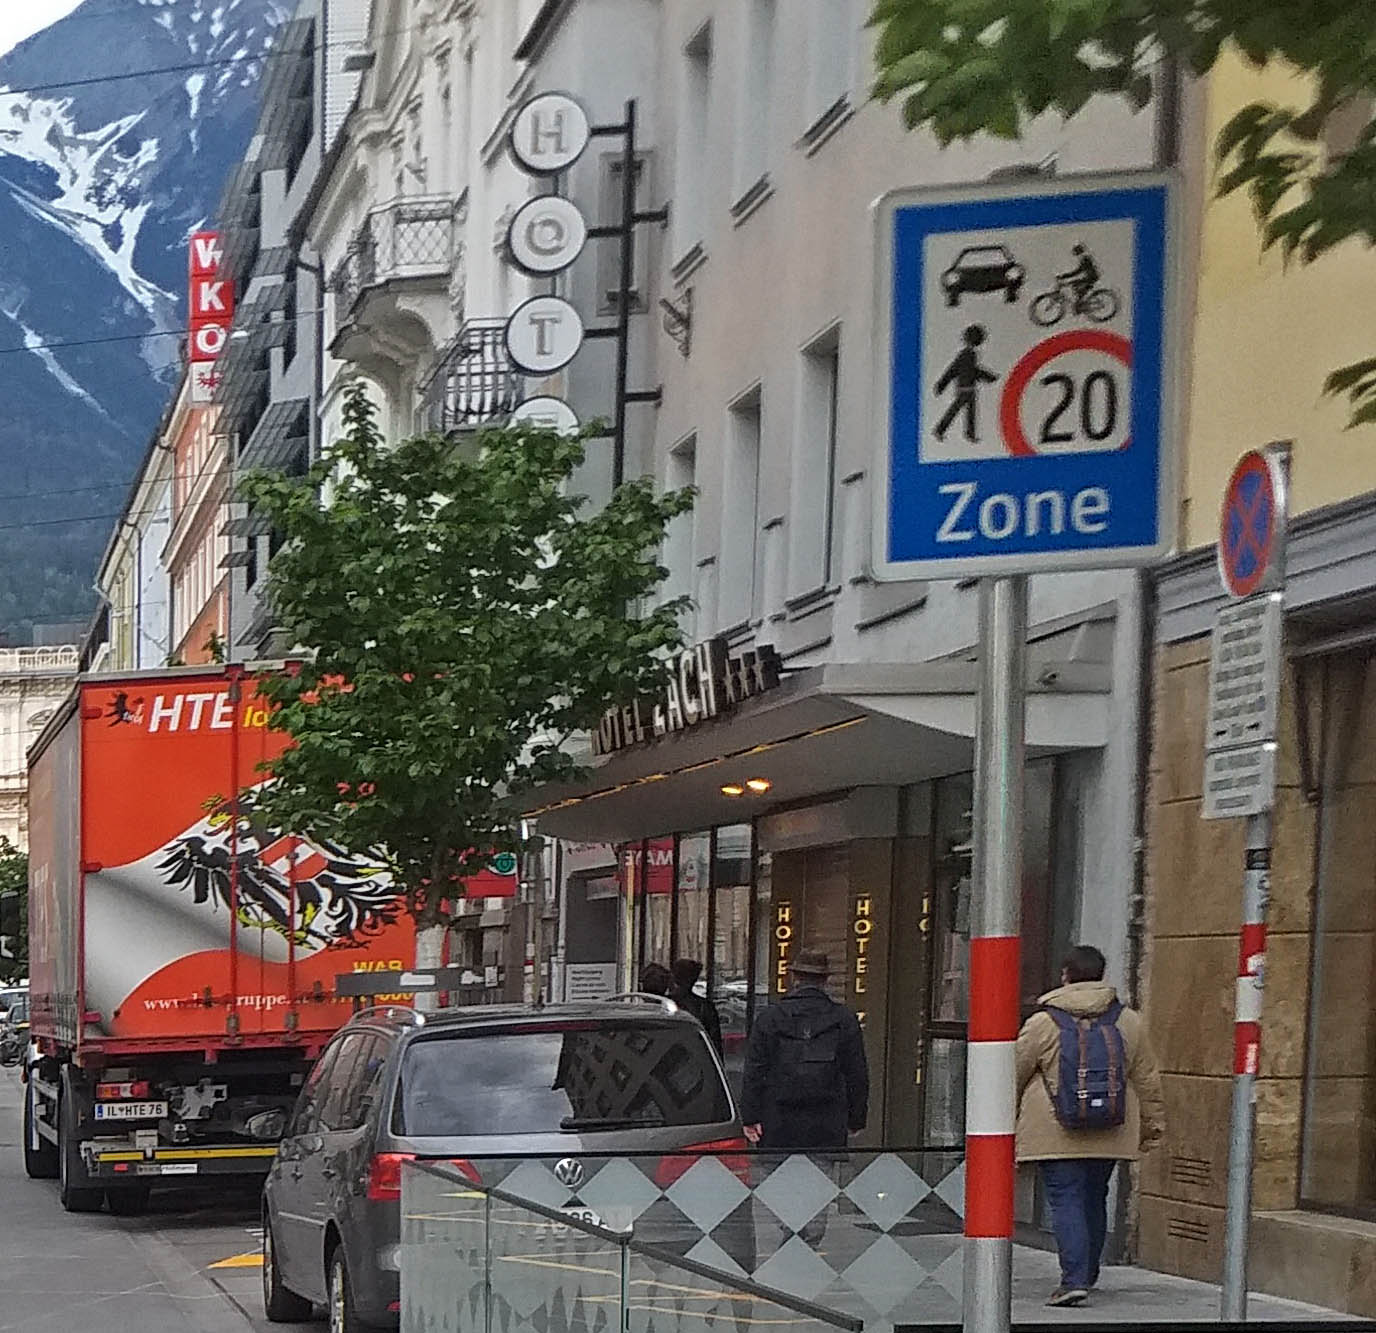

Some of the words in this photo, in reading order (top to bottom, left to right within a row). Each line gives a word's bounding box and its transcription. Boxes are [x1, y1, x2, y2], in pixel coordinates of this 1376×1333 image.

[1038, 370, 1118, 446] 20
[936, 482, 1111, 543] Zone
[149, 692, 233, 733] HTE
[776, 907, 791, 993] HOTEL
[854, 899, 871, 993] HOTEL
[126, 1104, 147, 1115] HTE
[149, 1104, 163, 1114] 76
